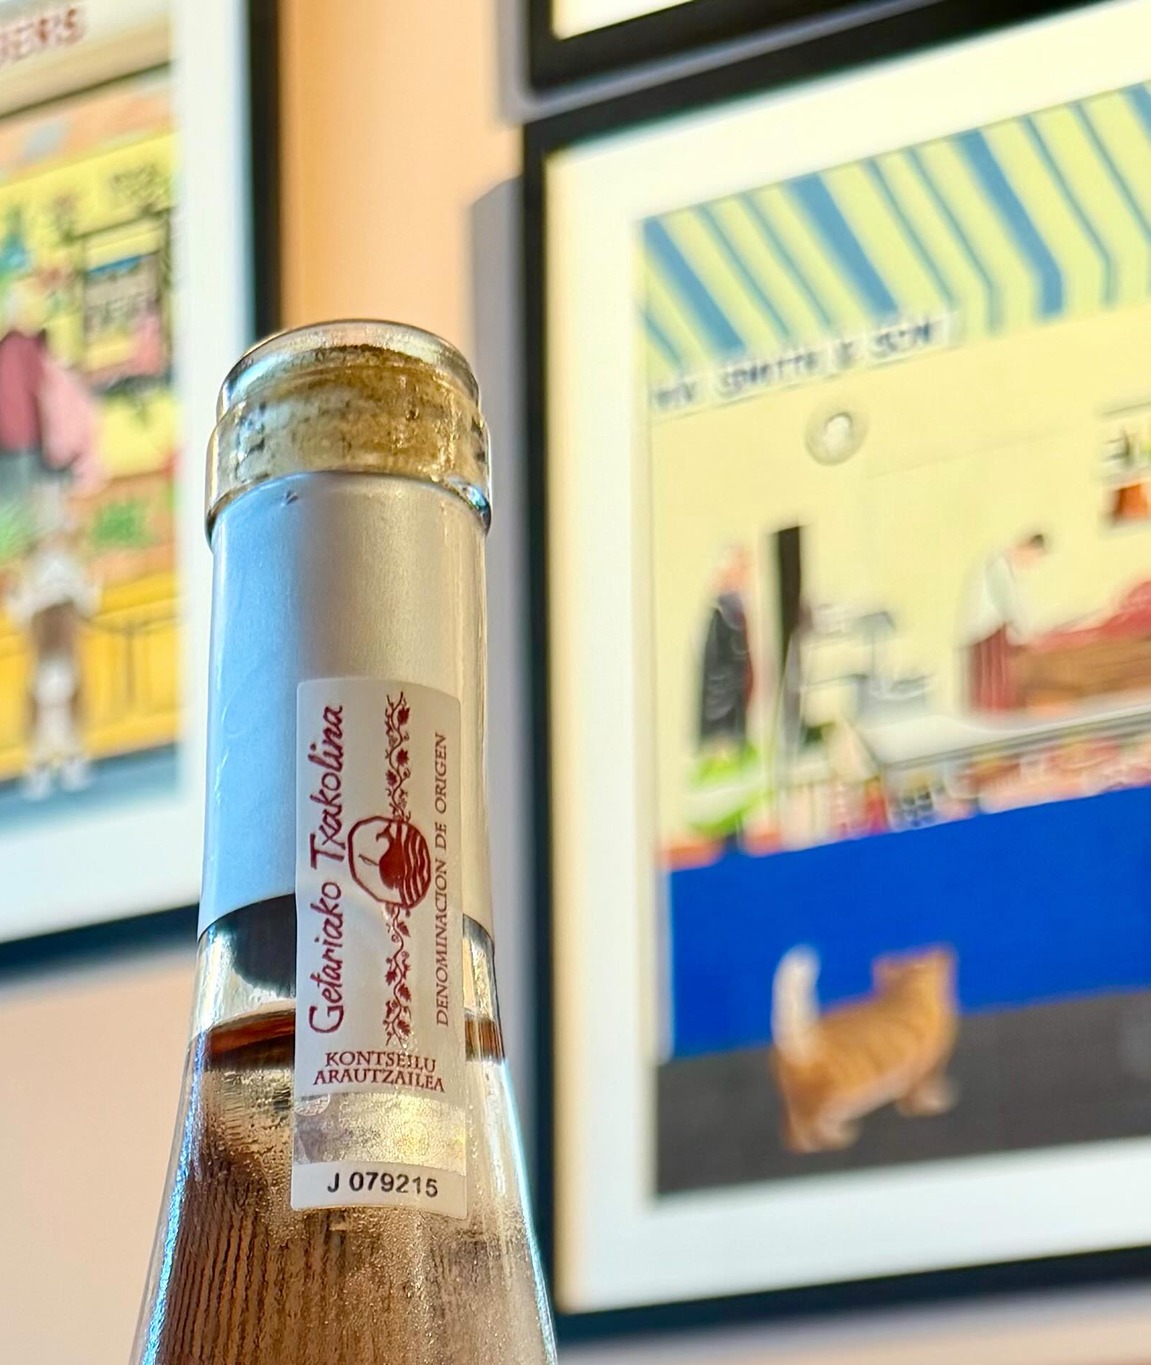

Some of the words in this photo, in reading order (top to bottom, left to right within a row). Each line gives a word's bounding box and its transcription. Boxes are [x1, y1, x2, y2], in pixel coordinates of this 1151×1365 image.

[308, 705, 345, 868] Txakolina
[434, 731, 448, 814] ORIGEN
[434, 821, 447, 852] DE
[308, 881, 345, 1034] Getariako
[434, 859, 449, 1027] DENOMINACION
[313, 1068, 446, 1093] ARAUTZAILEA
[325, 1050, 437, 1073] KONTSEILU
[327, 1172, 340, 1193] J
[348, 1171, 439, 1198] 079215
